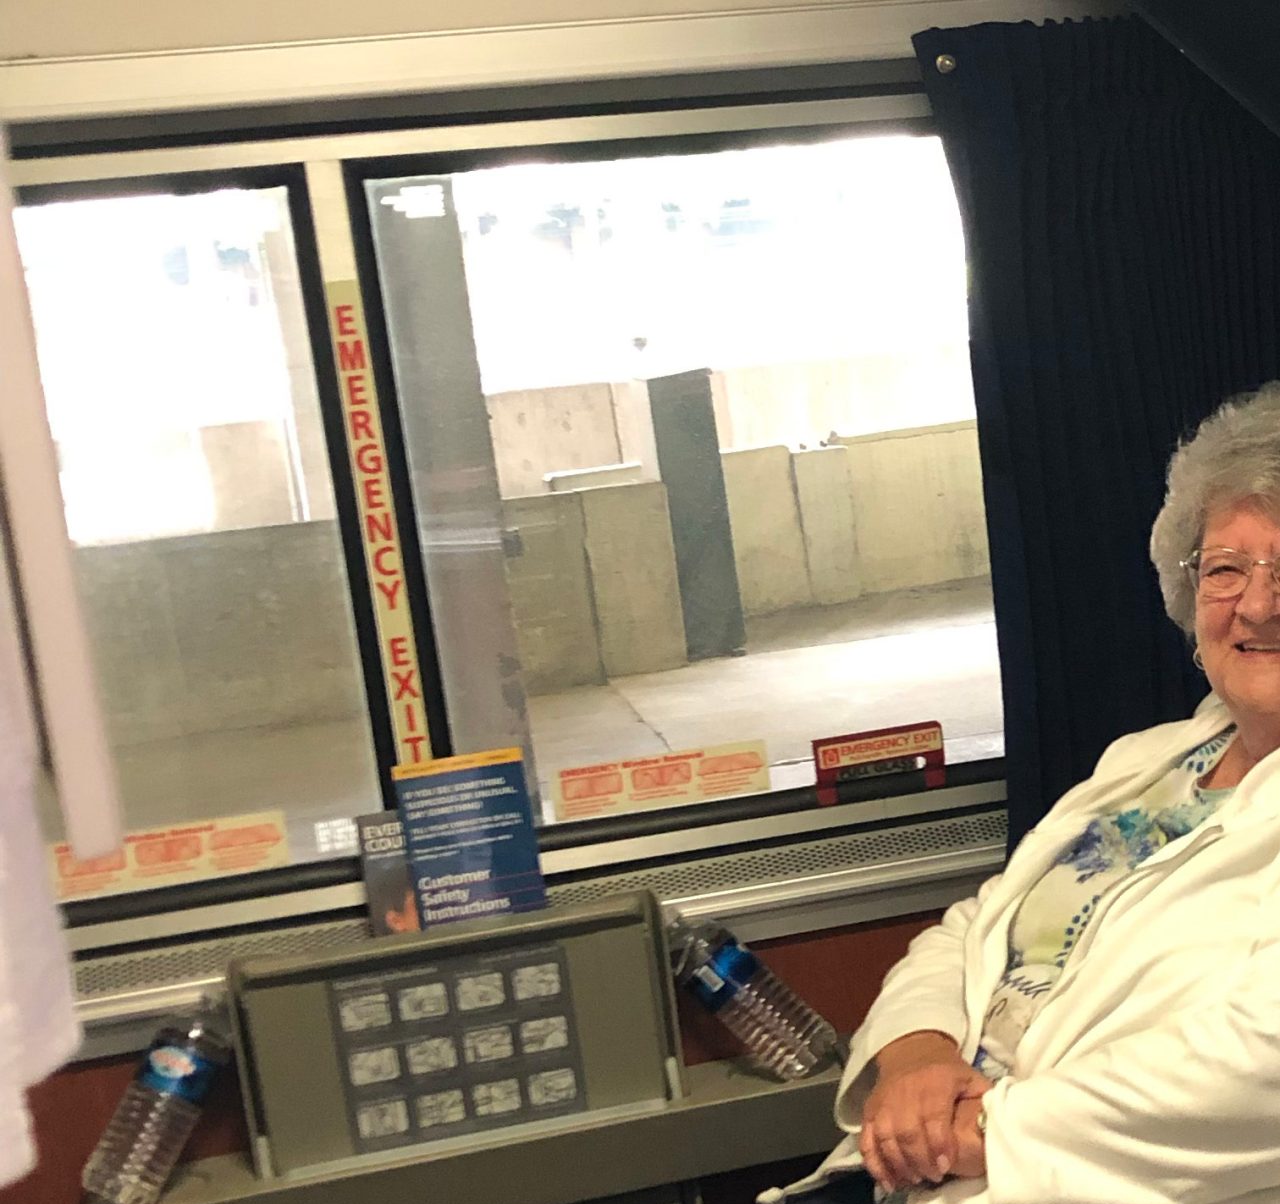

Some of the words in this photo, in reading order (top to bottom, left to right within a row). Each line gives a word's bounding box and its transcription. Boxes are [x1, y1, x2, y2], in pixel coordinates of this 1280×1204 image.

[335, 304, 401, 610] EMERGENCY
[389, 637, 426, 763] EXIT
[840, 736, 910, 755] EMERGENCY
[914, 731, 939, 743] EXIT
[418, 869, 491, 890] Customer
[421, 888, 470, 907] Safety
[423, 897, 511, 921] Instructions
